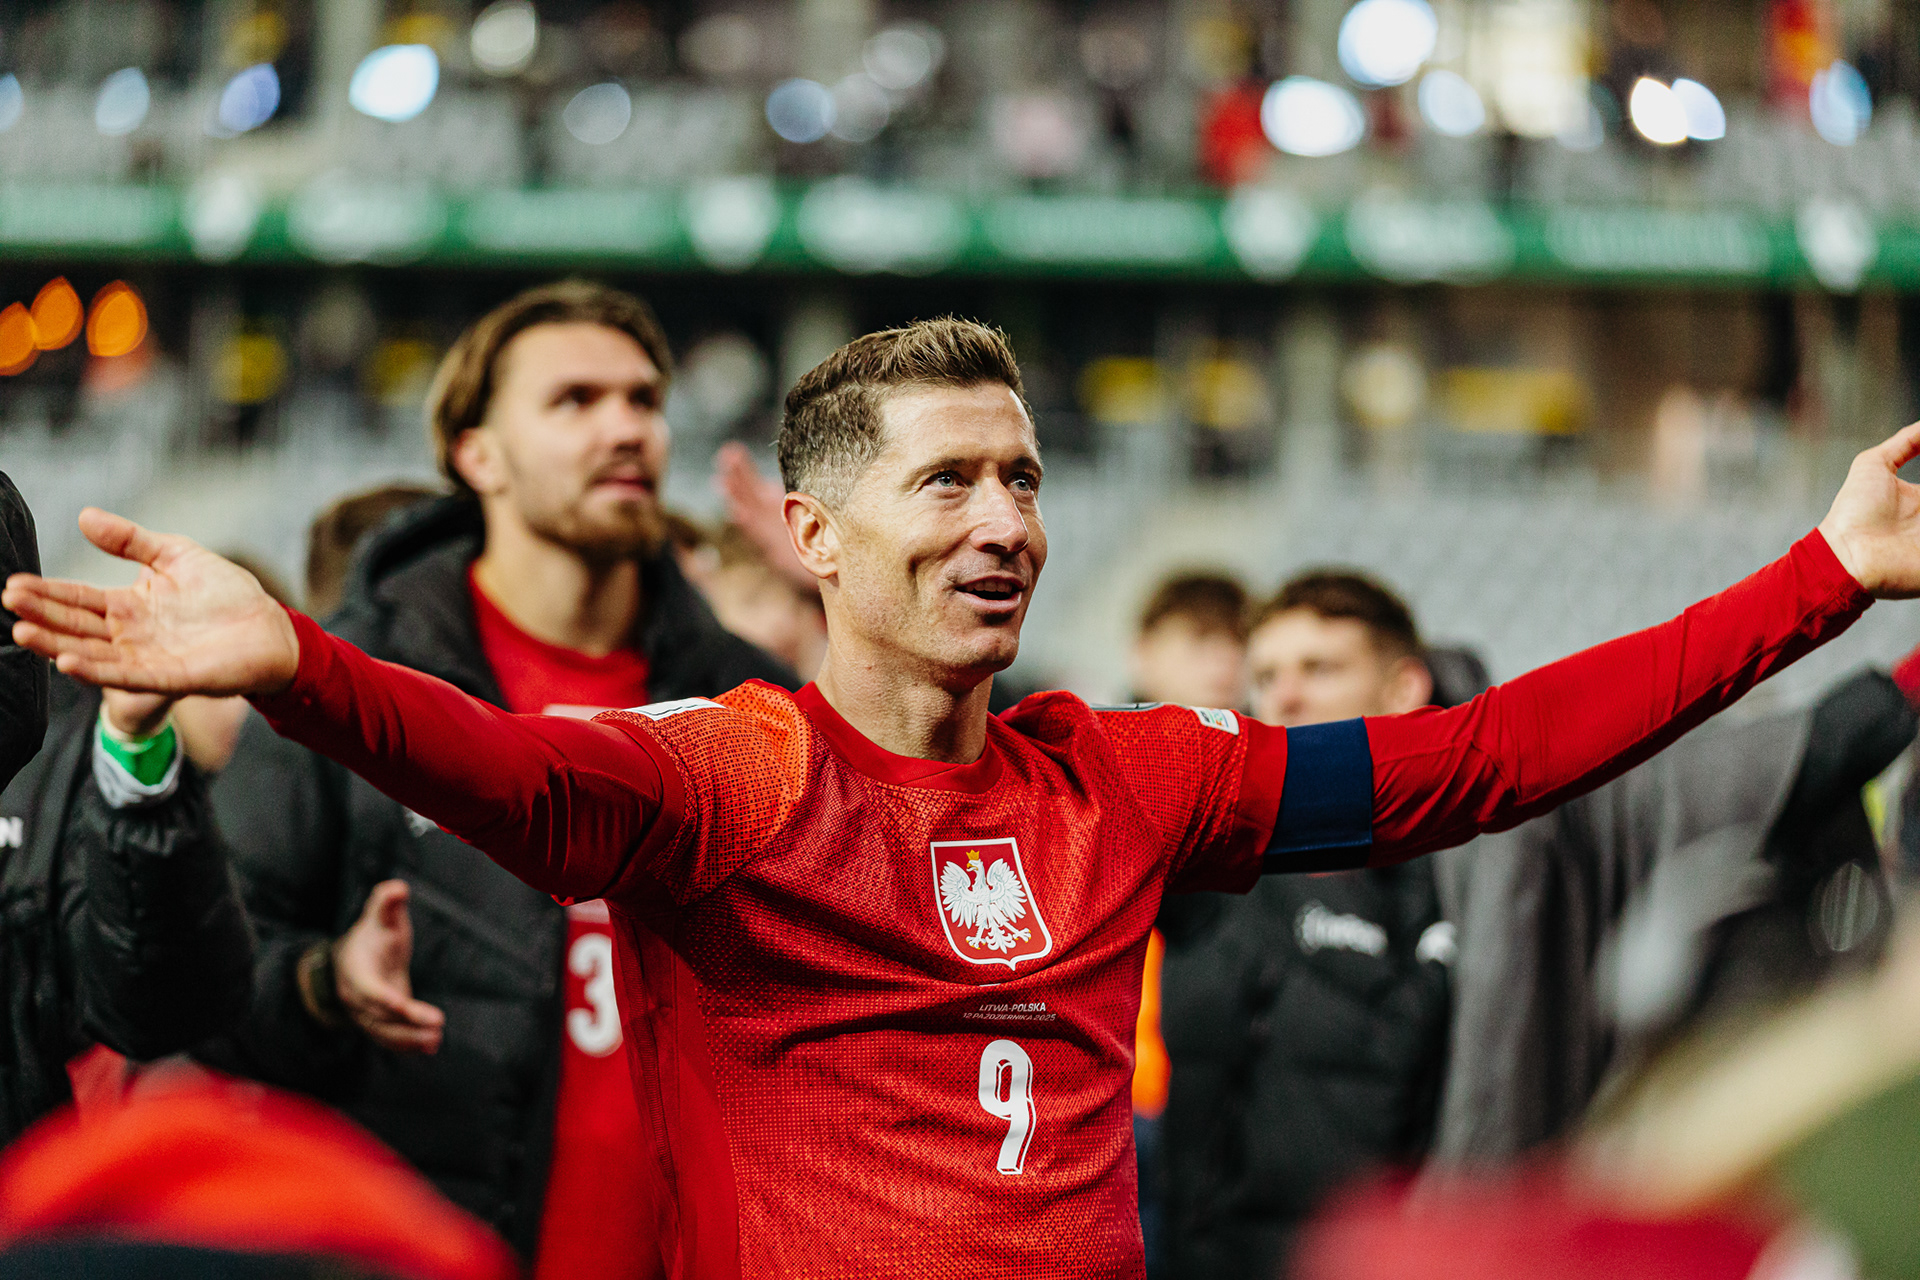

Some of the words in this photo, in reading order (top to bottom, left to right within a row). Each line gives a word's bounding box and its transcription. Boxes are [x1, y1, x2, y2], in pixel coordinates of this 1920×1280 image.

[567, 932, 624, 1058] 3
[979, 1002, 1047, 1012] LITWA-POLSKA
[1033, 1013, 1057, 1021] 2025
[978, 1039, 1037, 1175] 9
